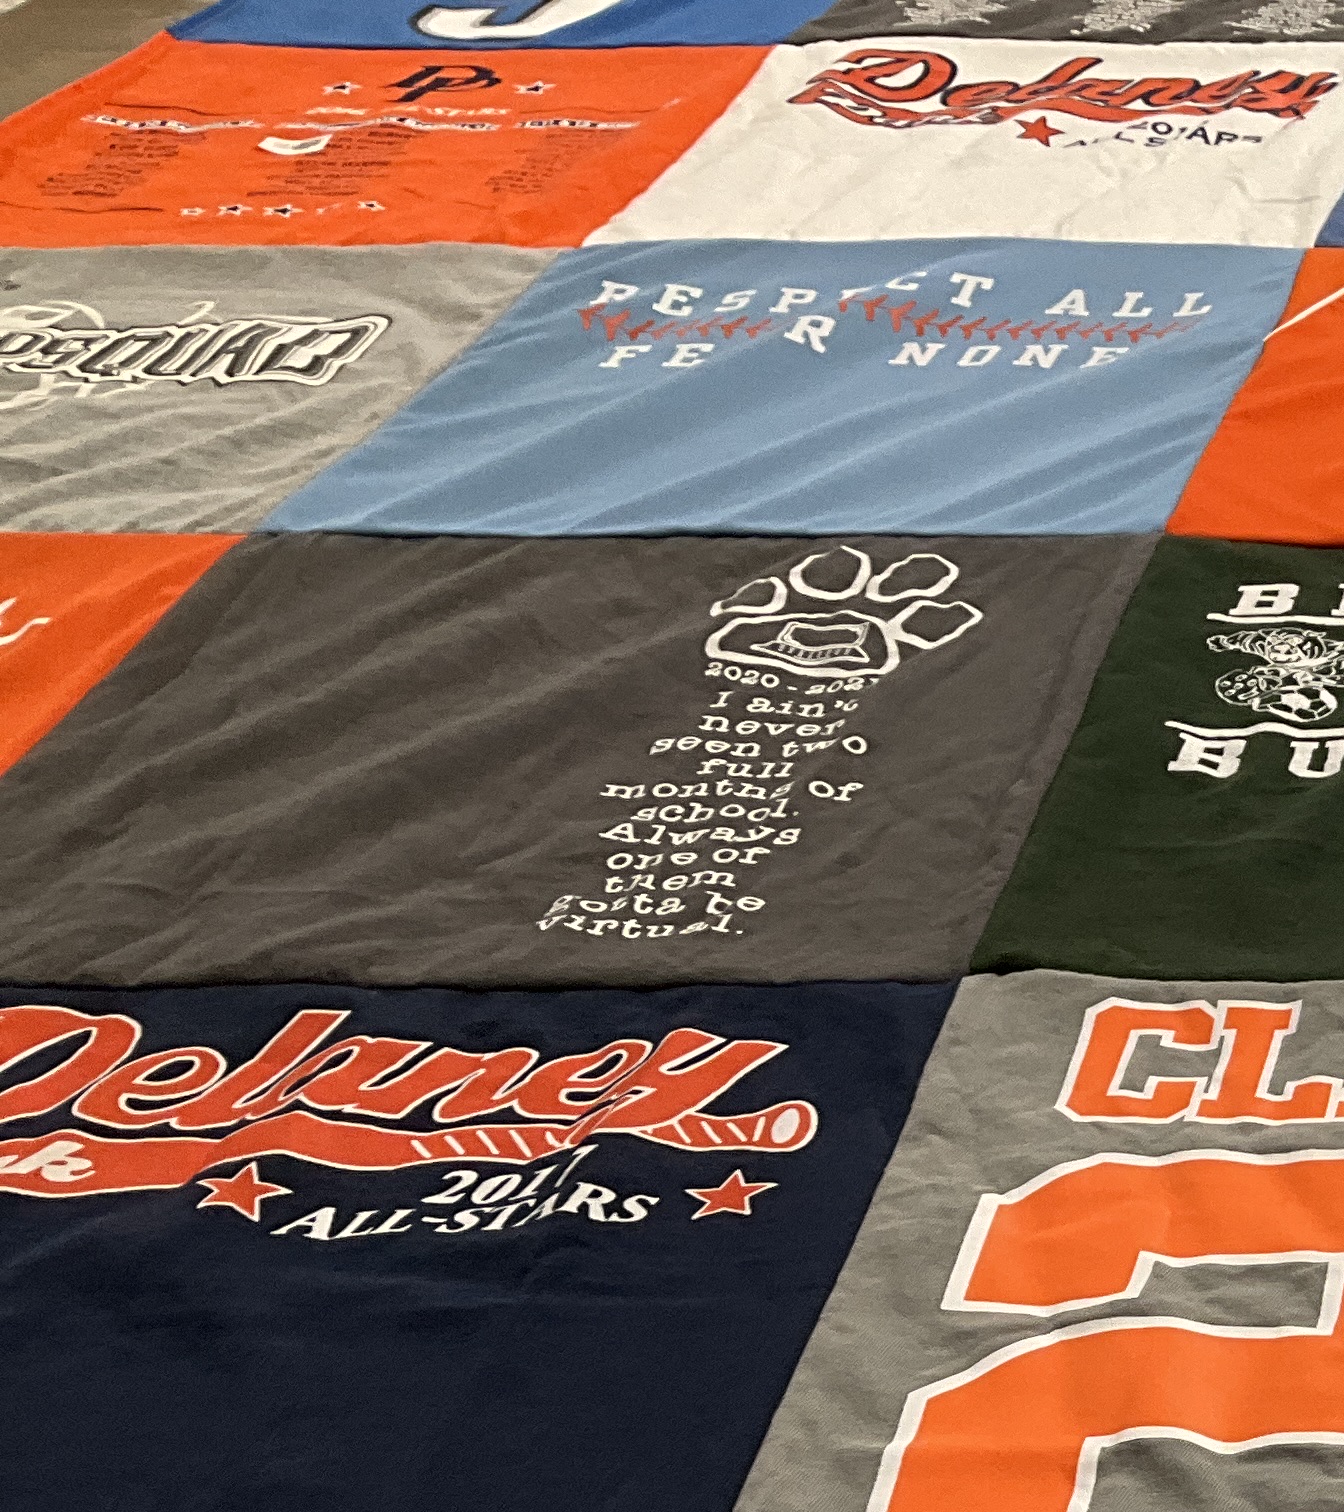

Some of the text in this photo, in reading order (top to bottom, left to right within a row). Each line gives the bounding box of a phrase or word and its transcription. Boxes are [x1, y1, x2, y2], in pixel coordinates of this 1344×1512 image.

[1045, 288, 1213, 317] ALL
[599, 314, 1129, 369] FER NONE
[704, 661, 780, 689] 2020
[709, 691, 860, 719] I ain't
[699, 714, 846, 736] never
[649, 735, 869, 757] seen two
[696, 758, 794, 778] full
[600, 779, 864, 801] months of
[631, 798, 800, 823] school.
[598, 823, 802, 846] Always
[606, 846, 771, 870] one of
[604, 870, 737, 894] them
[543, 890, 766, 916] gotta be
[535, 913, 745, 939] virtual.
[422, 1145, 589, 1206] 2017
[271, 1187, 661, 1241] ALL-STARS
